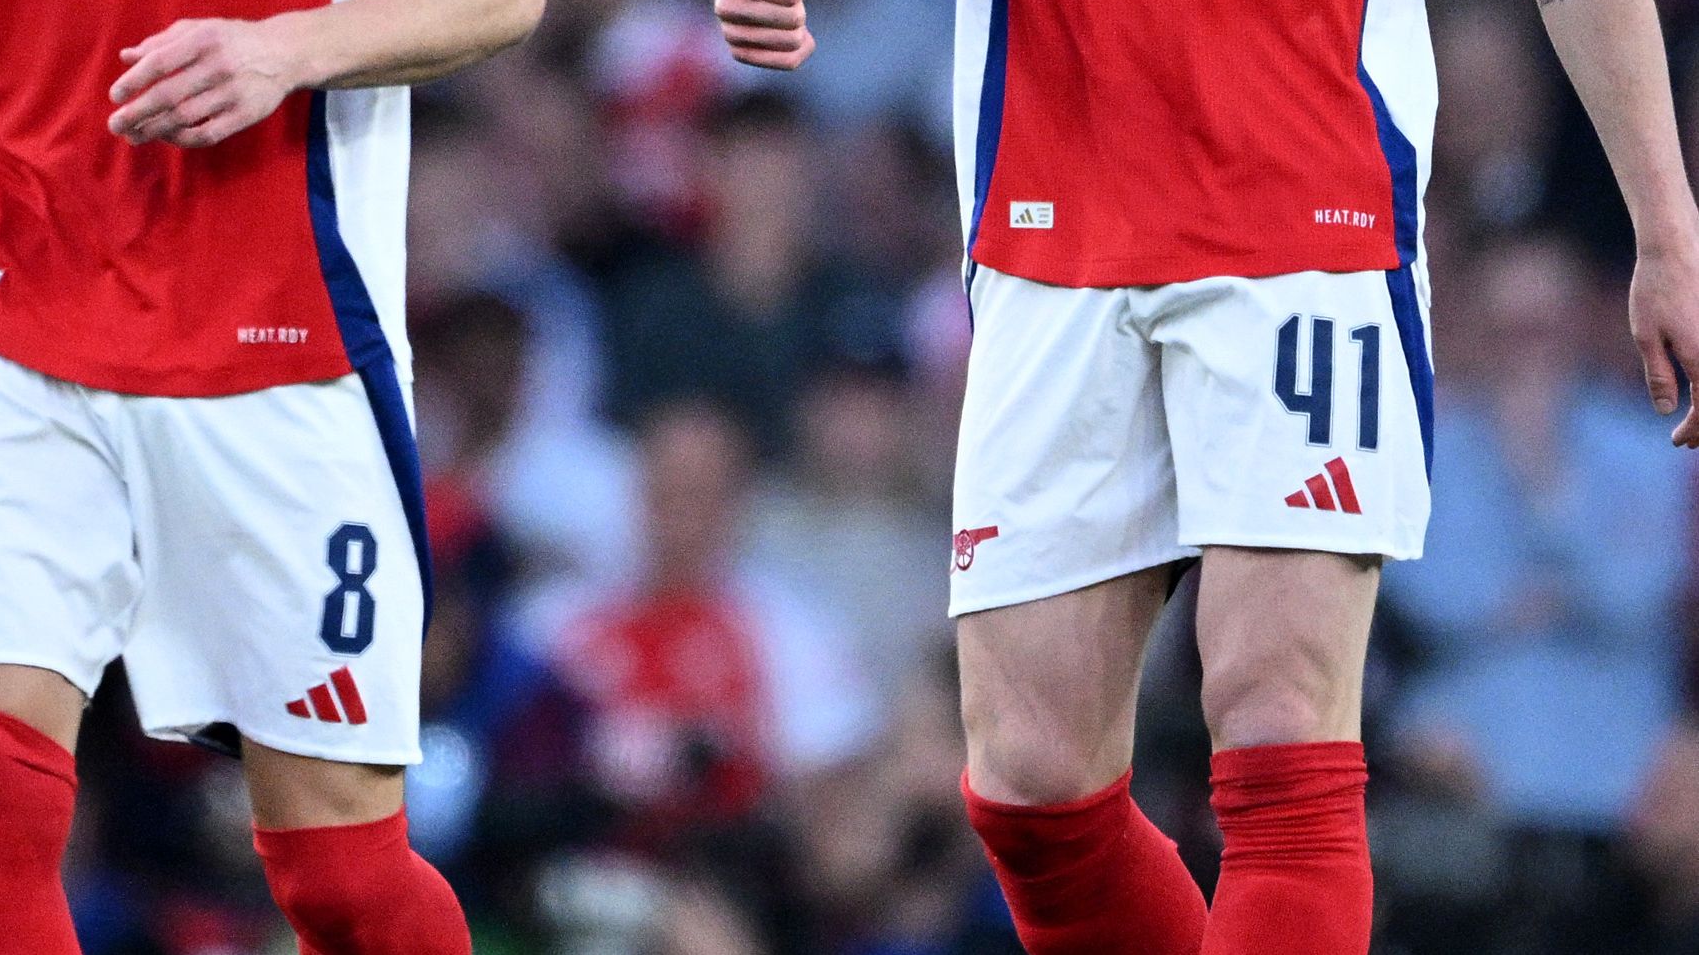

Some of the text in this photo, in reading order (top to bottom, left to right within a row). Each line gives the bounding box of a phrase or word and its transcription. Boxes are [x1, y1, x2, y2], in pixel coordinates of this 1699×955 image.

[1314, 209, 1376, 229] HEAT.RDY
[1272, 312, 1382, 453] 41
[317, 521, 379, 658] 8
